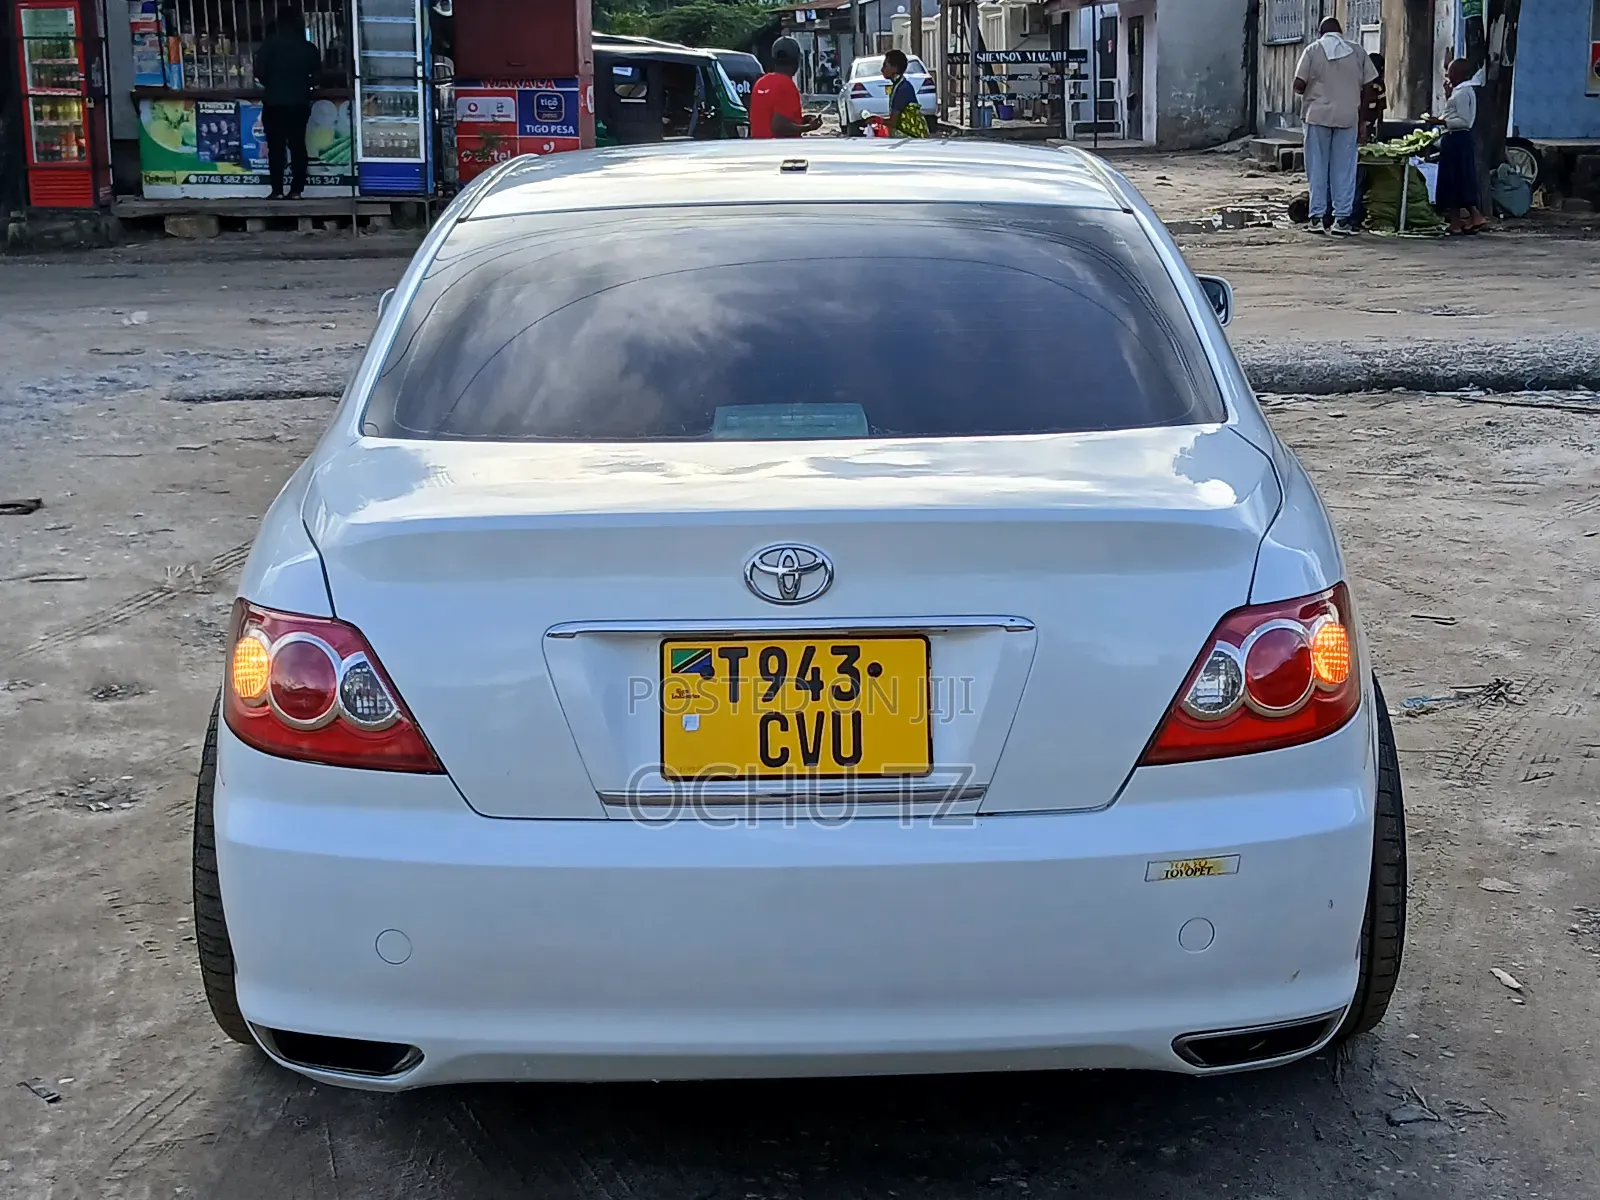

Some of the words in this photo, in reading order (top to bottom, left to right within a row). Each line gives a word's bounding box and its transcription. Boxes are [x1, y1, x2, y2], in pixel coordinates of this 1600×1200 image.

[481, 79, 556, 89] WAKALA
[540, 97, 559, 110] tigo
[525, 125, 549, 134] TIGO
[551, 125, 575, 134] PESA
[323, 176, 340, 185] 347
[758, 710, 862, 768] CVU
